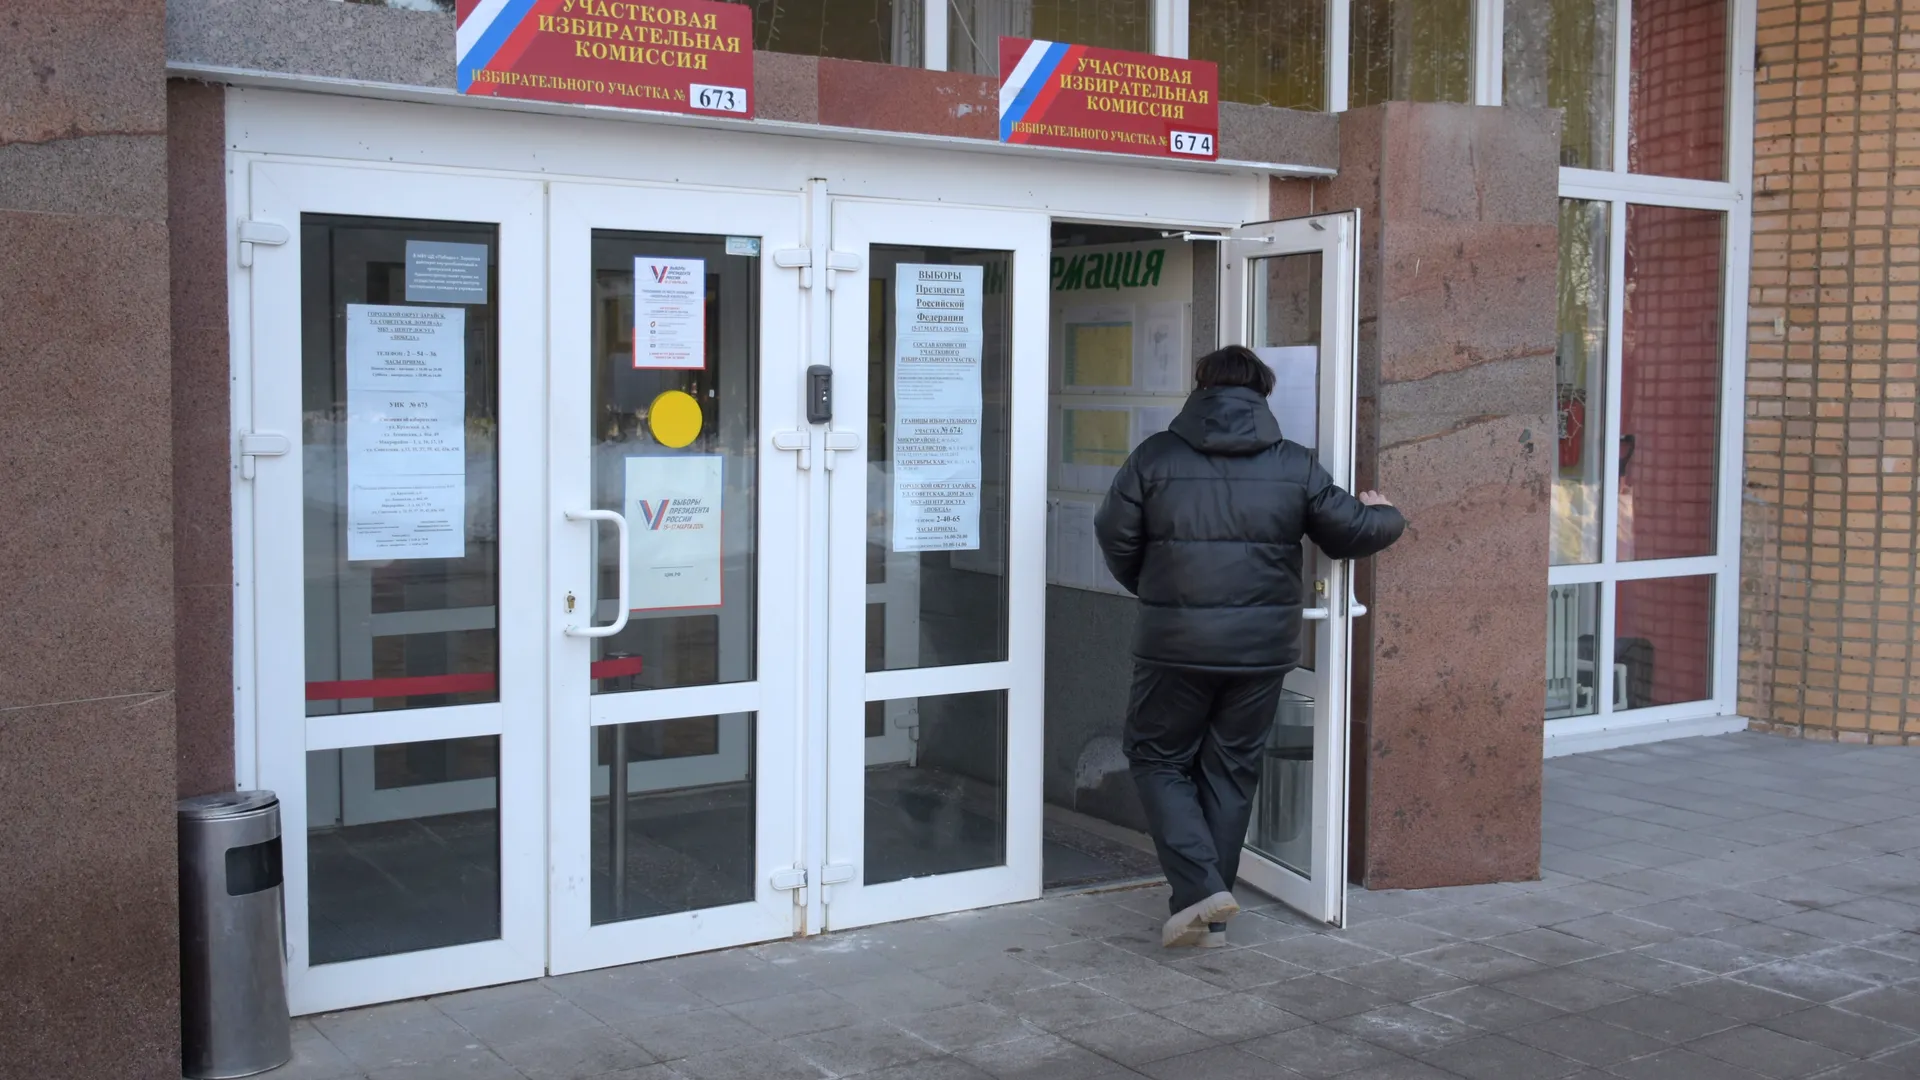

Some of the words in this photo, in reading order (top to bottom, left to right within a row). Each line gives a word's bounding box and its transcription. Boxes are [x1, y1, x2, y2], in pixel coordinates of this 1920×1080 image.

[562, 0, 718, 30] УЧАСТКОВАЯ
[537, 14, 741, 53] ИЗБИРАТЕЛЬНАЯ
[575, 40, 708, 70] КОМИССИЯ
[1077, 57, 1192, 85] УЧАСТКОВАЯ
[471, 68, 605, 93] ИЗБИРАТЕЛЬНОГО
[608, 81, 671, 100] УЧАСТКА
[699, 88, 736, 110] 673
[1060, 74, 1209, 104] ИЗБИРАТЕЛЬНАЯ
[1086, 95, 1185, 120] КОМИССИЯ
[1011, 121, 1109, 141] ИЗБИРАТЕЛЬНОГО
[1110, 130, 1156, 146] УЧАСТКА
[918, 270, 962, 281] ВЫБОРЫ
[916, 284, 965, 294] Президента
[916, 298, 964, 308] Российской
[916, 312, 964, 322] Федерации
[669, 506, 710, 514] ПРЕЗИДЕНТА
